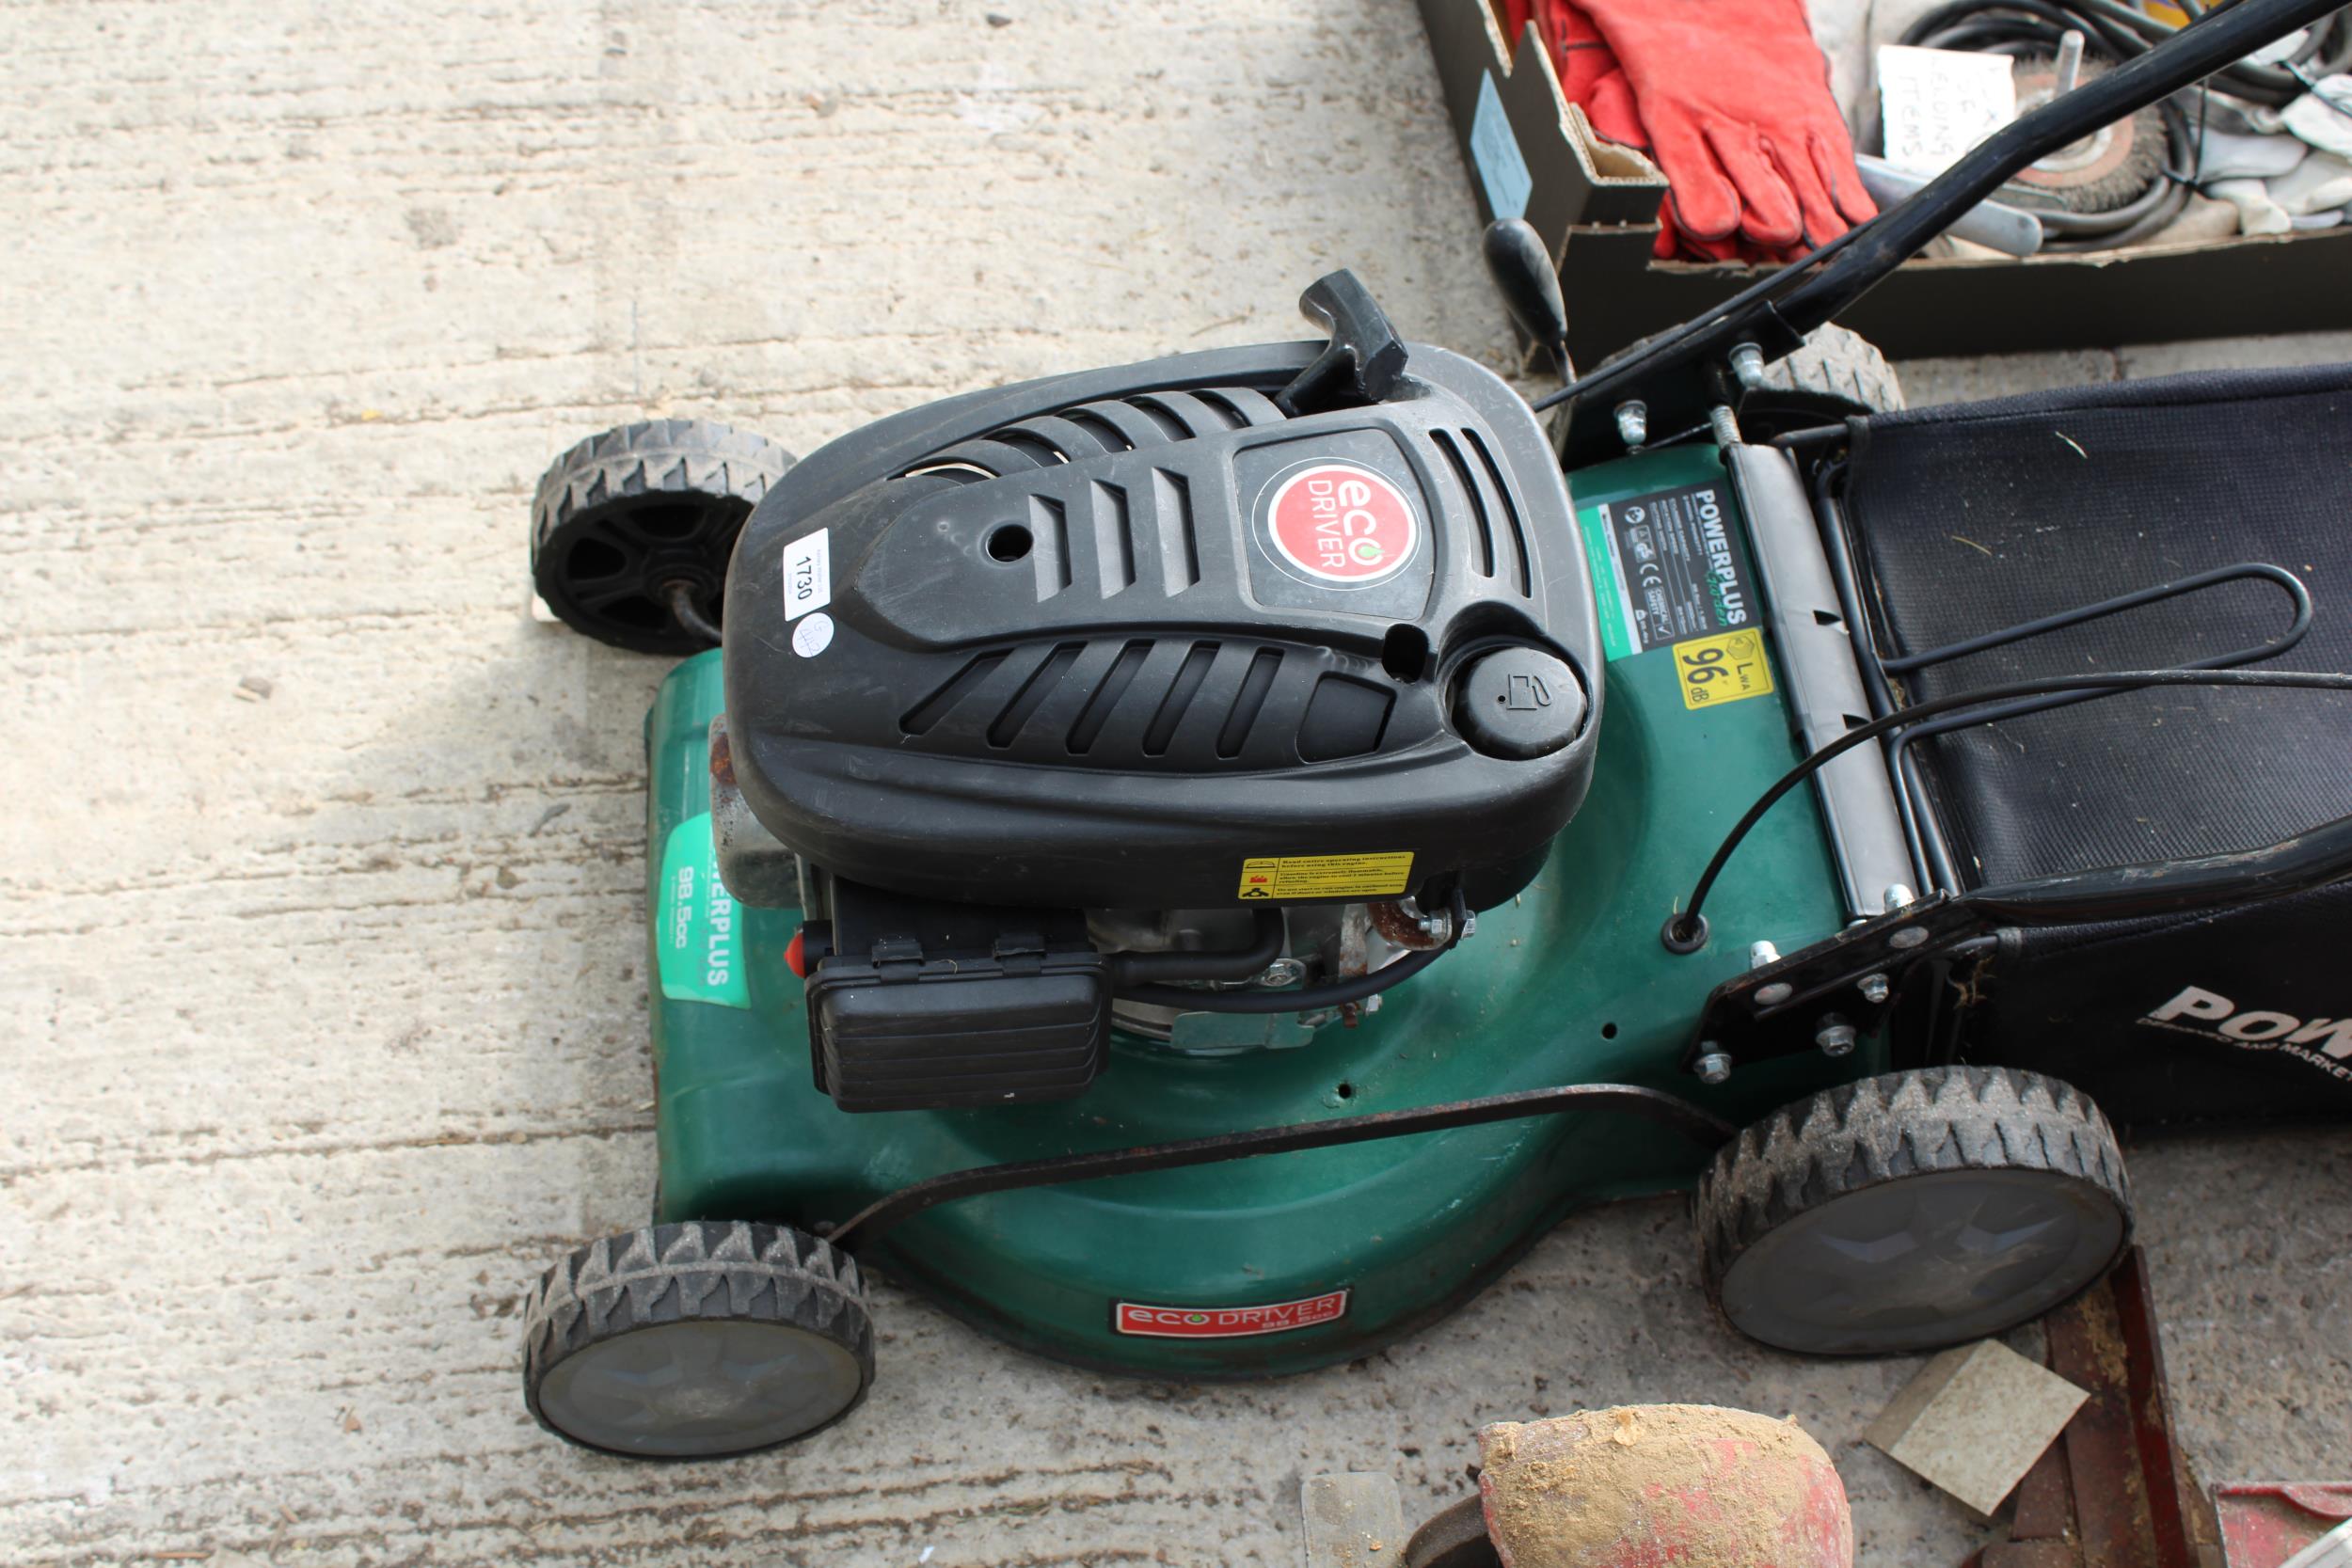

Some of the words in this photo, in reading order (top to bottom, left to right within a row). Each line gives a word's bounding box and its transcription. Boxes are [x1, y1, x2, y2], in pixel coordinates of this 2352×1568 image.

[1308, 480, 1345, 567] DRIVER
[1338, 480, 1384, 565] eco
[797, 557, 813, 600] 1730
[1696, 489, 1746, 625] POWERPLUS
[1682, 648, 1729, 684] 96
[1691, 688, 1709, 703] dB
[675, 866, 693, 949] 98.5cc
[1128, 1309, 1210, 1325] eco
[1219, 1298, 1336, 1325] DRIVER
